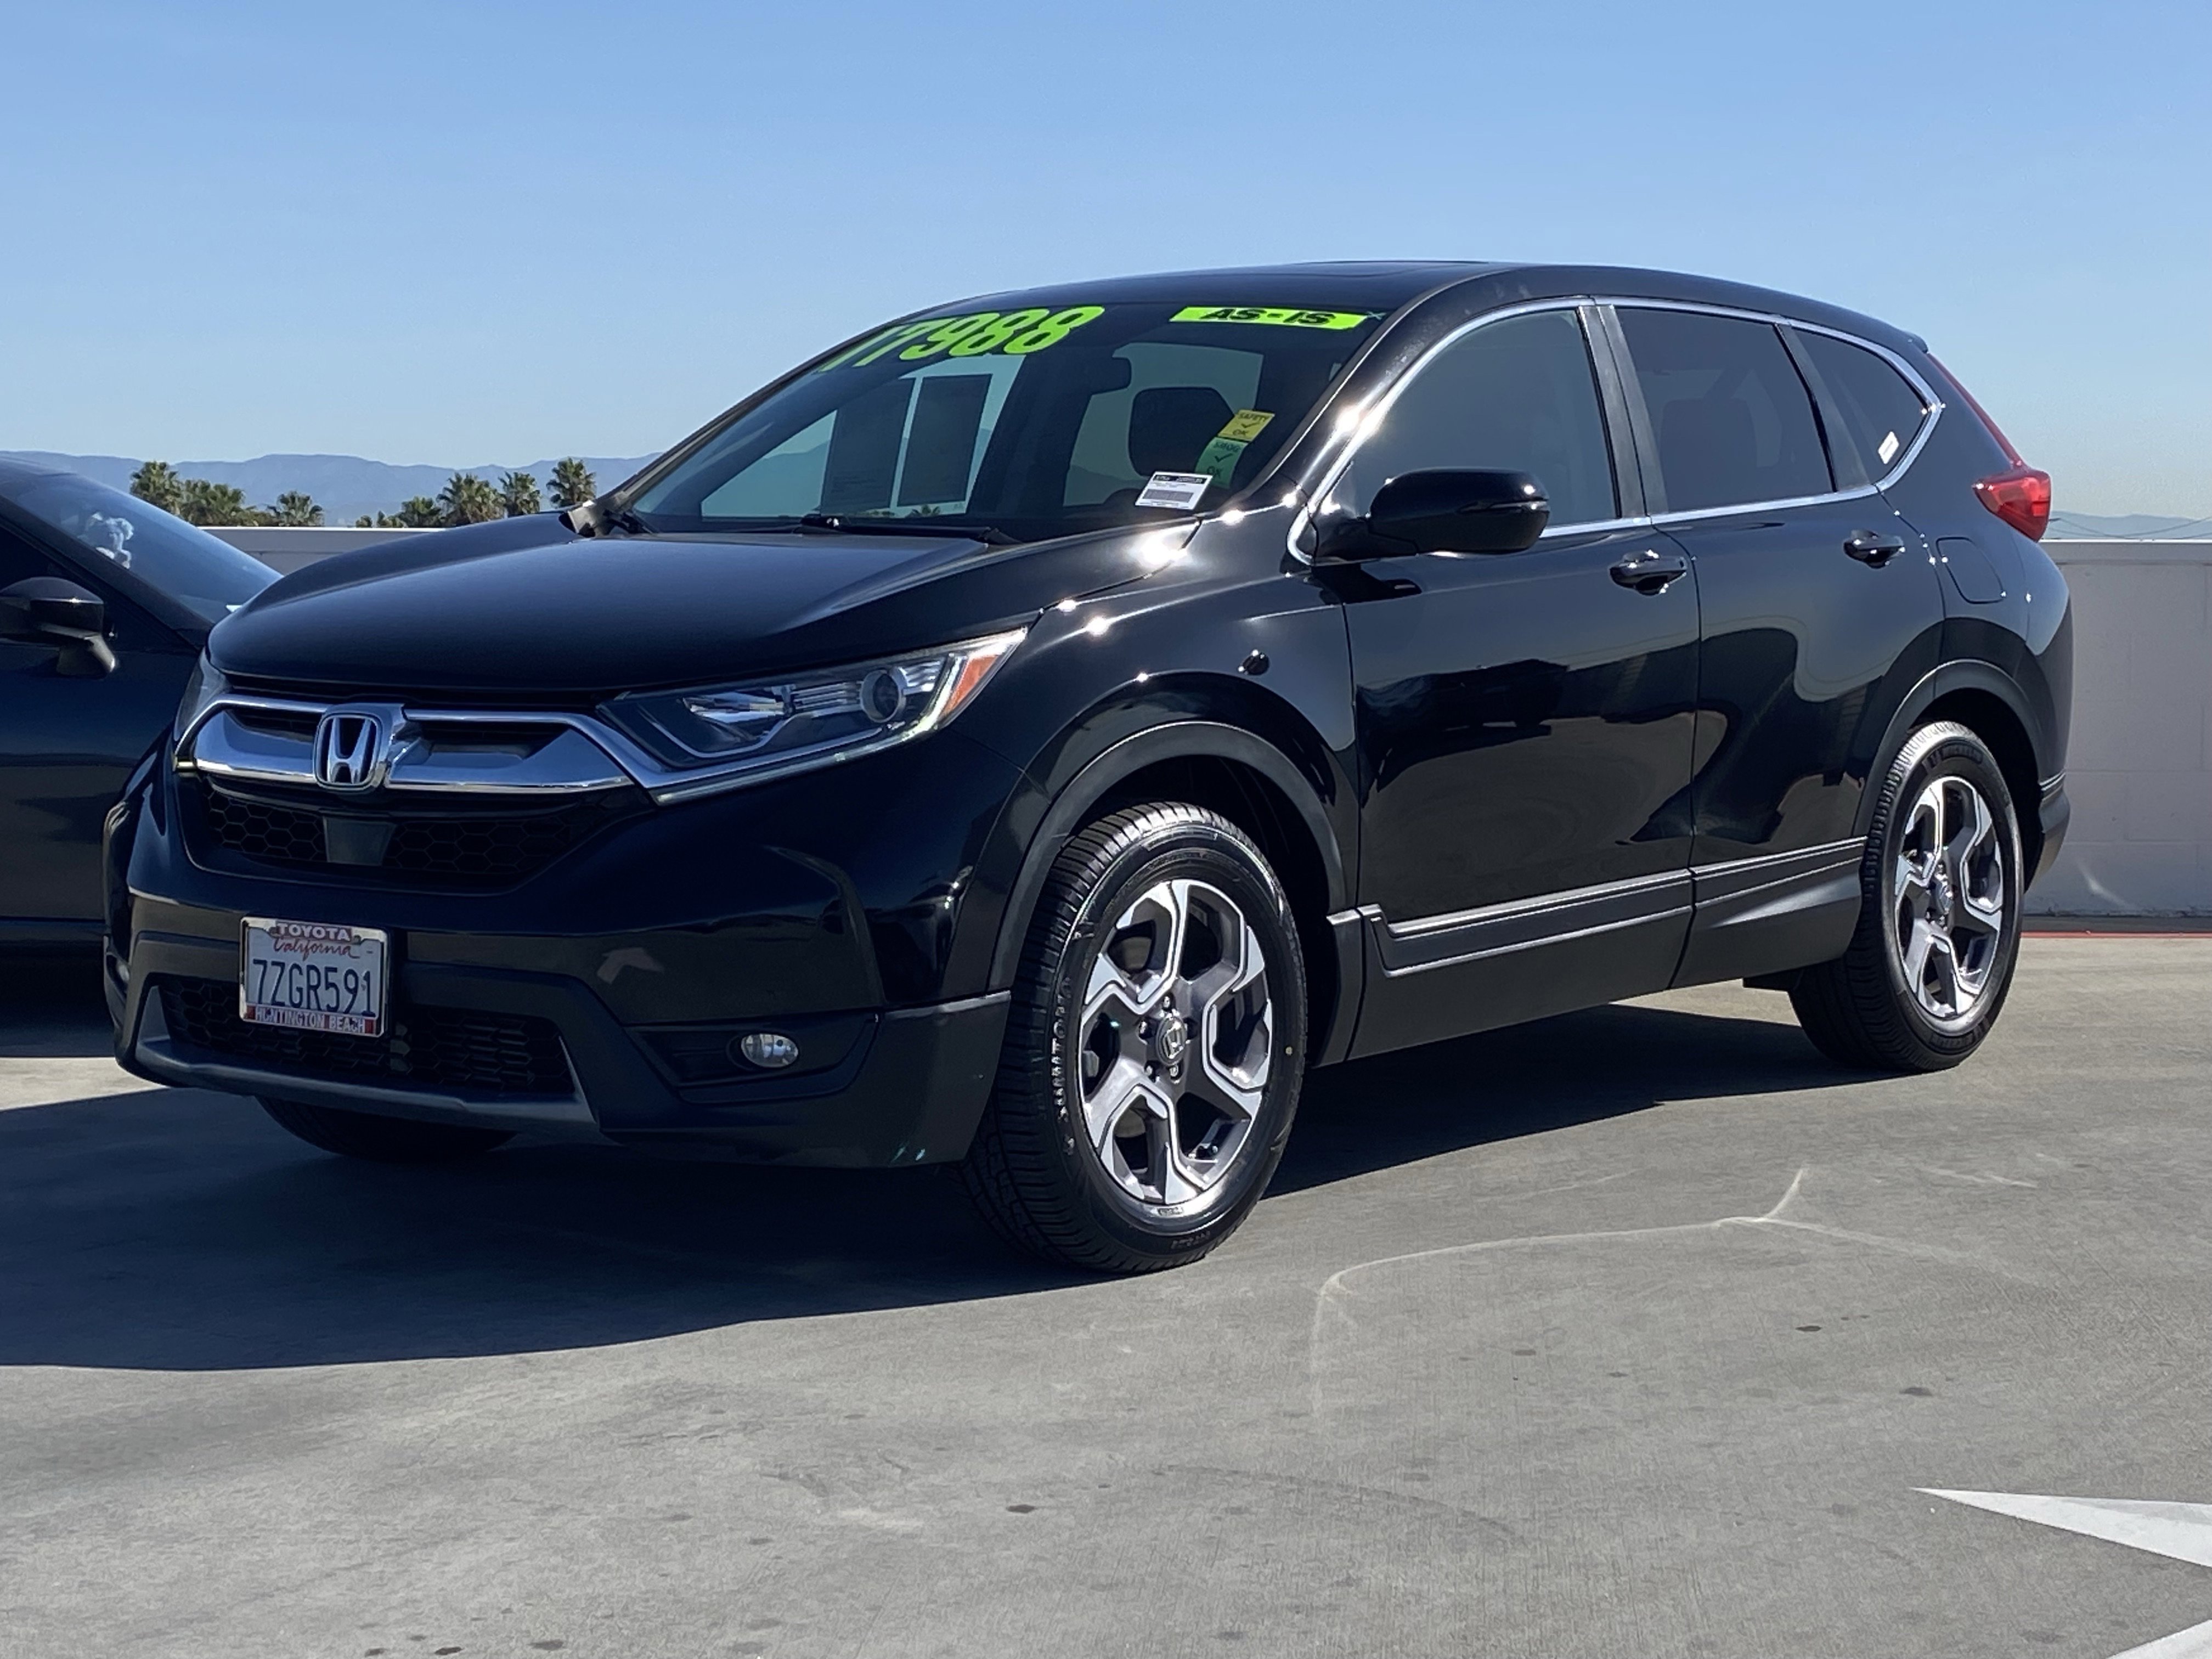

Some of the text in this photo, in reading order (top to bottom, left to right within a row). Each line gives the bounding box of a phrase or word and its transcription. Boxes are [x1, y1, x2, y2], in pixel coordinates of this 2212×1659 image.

[1200, 308, 1336, 325] AS-IS
[817, 305, 1105, 373] 17988
[1207, 466, 1223, 479] OK
[275, 923, 351, 941] TOYOTA
[274, 937, 360, 961] California
[253, 958, 376, 1018] 7ZGR591
